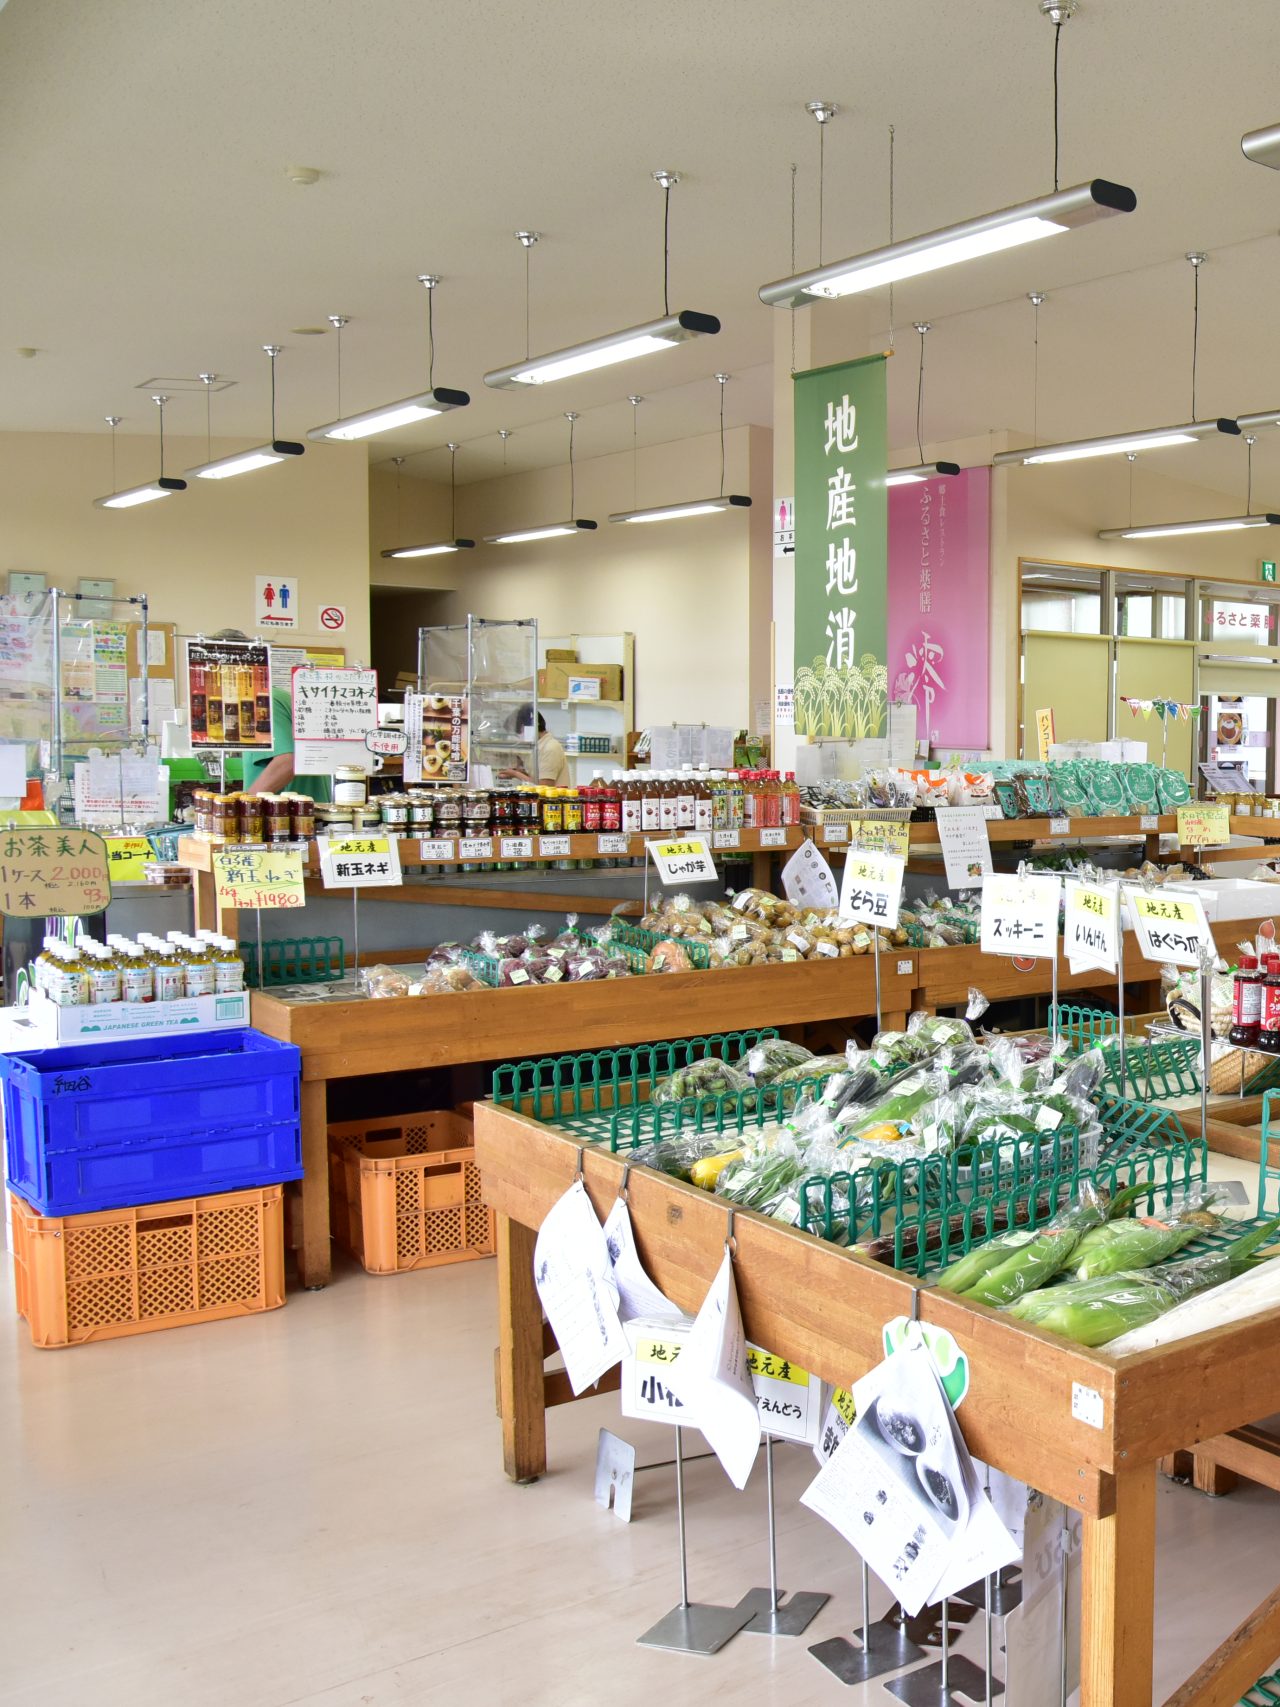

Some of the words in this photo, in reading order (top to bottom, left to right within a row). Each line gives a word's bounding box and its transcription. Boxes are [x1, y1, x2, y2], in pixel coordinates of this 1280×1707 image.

[824, 394, 859, 670] 地産地消
[919, 487, 933, 614] ふるさと薬膳
[299, 685, 377, 699] キサイチマヨネーズ
[371, 742, 399, 752] 不使用
[4, 835, 98, 857] お茶美人
[340, 842, 377, 852] 地元産
[667, 844, 694, 854] 地元産
[108, 850, 153, 862] 当コーナ
[336, 862, 389, 877] 新玉ネギ
[668, 861, 706, 875] じゃが芋
[850, 888, 888, 917] そら豆
[1083, 894, 1104, 915] 地元産
[1146, 902, 1184, 920] 地元産
[993, 918, 1044, 939] ズッキーニ
[1075, 924, 1107, 952] いんげん
[103, 1021, 140, 1031] JAPANESE
[142, 1020, 164, 1028] GREEN
[746, 1353, 791, 1380] 地元産
[756, 1396, 801, 1418] えんどう
